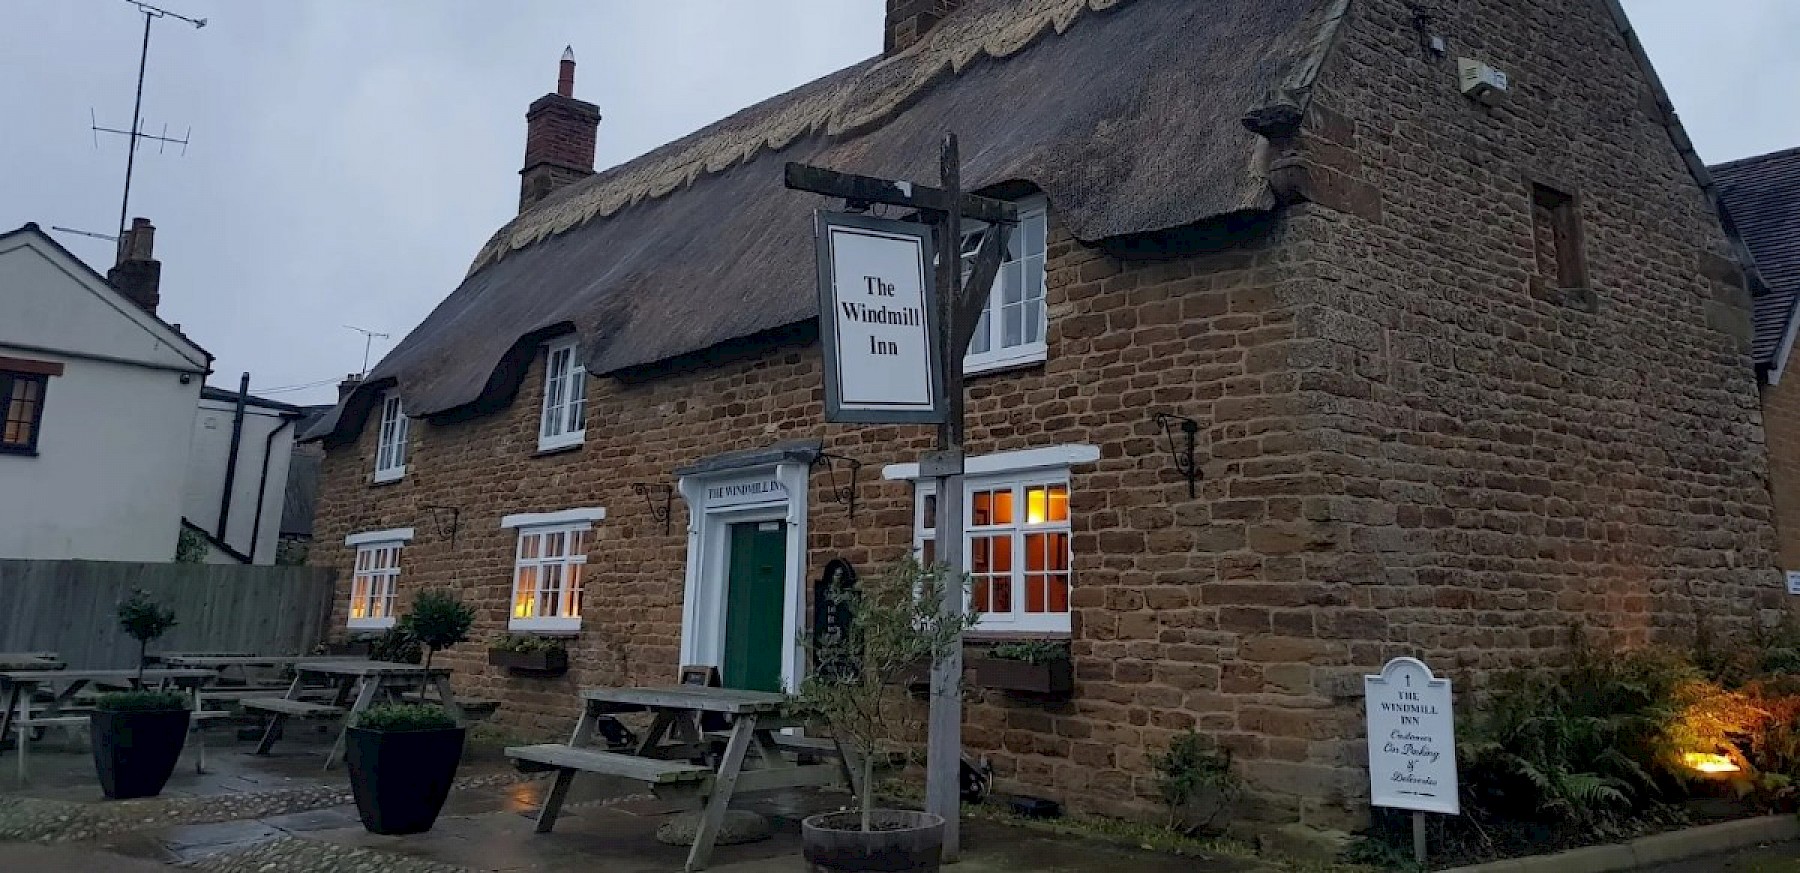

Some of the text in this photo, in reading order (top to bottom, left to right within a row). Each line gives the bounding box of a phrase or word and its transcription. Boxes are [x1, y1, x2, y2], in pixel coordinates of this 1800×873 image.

[863, 275, 895, 297] The
[841, 301, 920, 326] Windmill
[869, 335, 898, 355] Inn
[708, 488, 724, 499] THE
[725, 482, 768, 495] WINDMILL
[1398, 691, 1420, 701] THE
[1381, 702, 1438, 714] WINDMILL
[1400, 715, 1420, 726] INN
[1383, 742, 1440, 763] Car Parking
